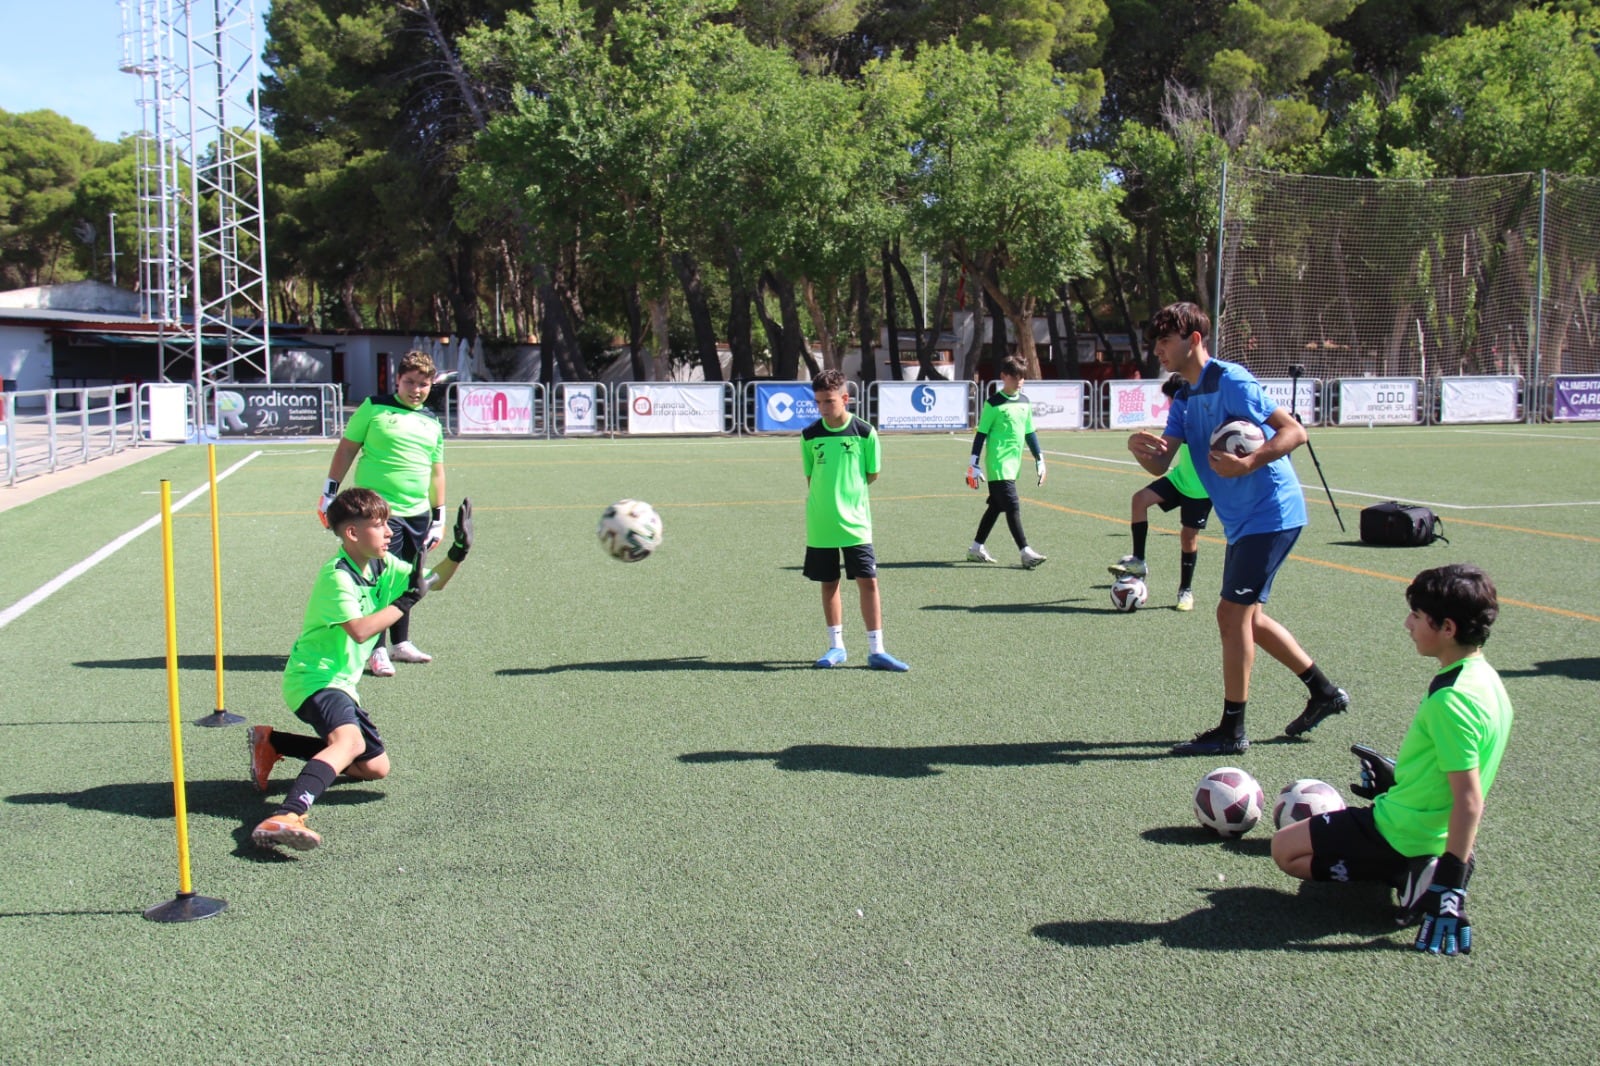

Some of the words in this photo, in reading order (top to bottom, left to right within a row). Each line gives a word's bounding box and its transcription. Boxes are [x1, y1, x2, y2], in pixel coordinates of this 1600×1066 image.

[1270, 387, 1312, 395] FRUAS
[249, 390, 318, 407] rodicam
[256, 408, 279, 428] 20
[887, 414, 960, 424] gruposampedro.com
